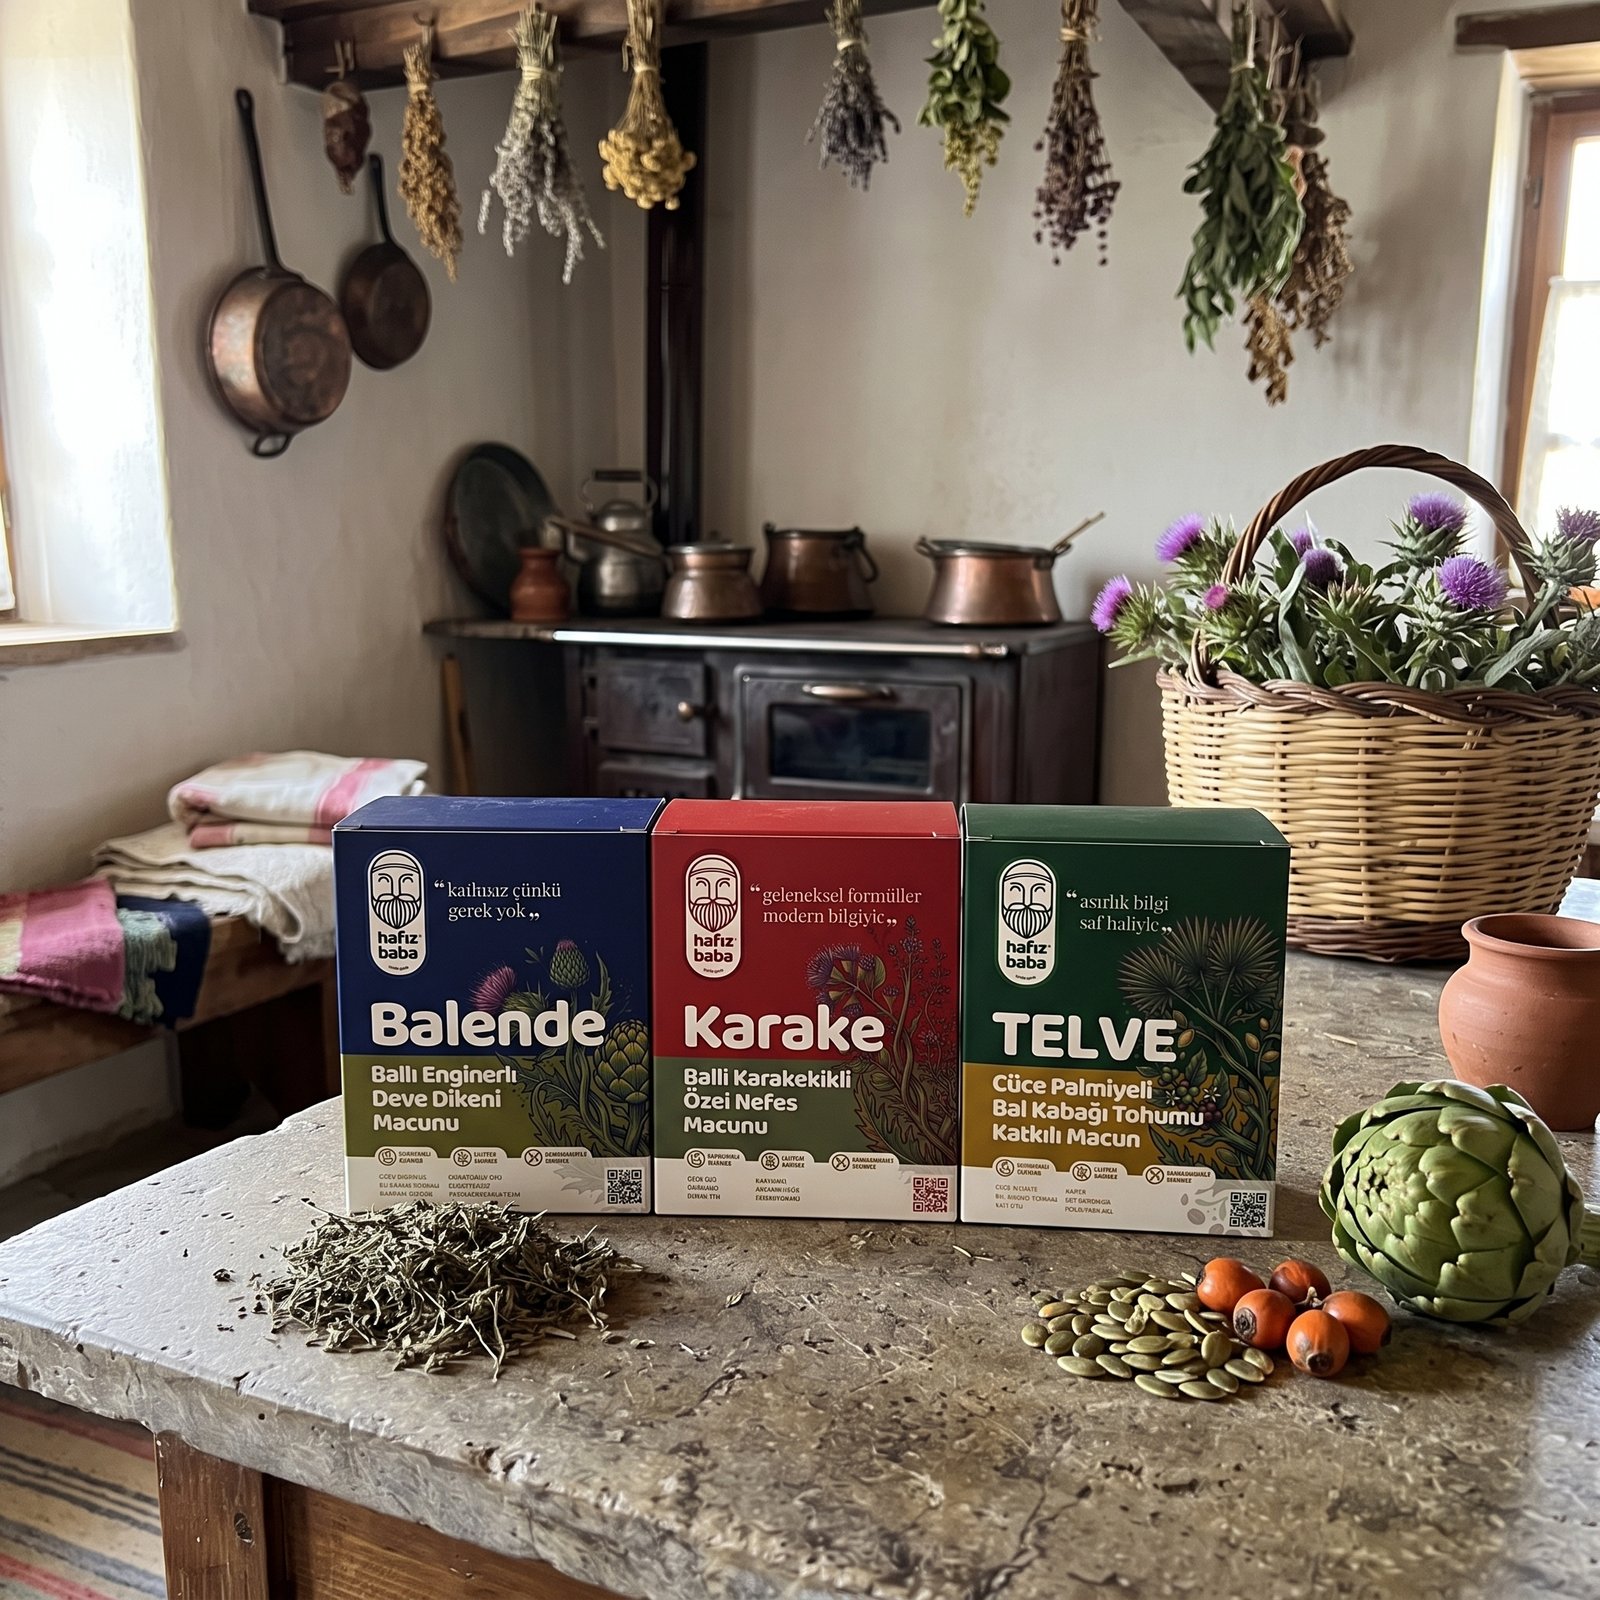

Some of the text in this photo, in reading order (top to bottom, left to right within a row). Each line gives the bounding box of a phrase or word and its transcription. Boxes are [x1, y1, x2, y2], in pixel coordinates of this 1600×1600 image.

[512, 882, 562, 901] çünkü
[847, 888, 922, 904] formüller
[448, 902, 493, 922] gerek
[1133, 894, 1169, 914] bilgi
[763, 908, 824, 924] modern
[1079, 915, 1104, 931] saf
[378, 945, 418, 960] baba
[694, 949, 733, 963] baba
[1006, 955, 1046, 970] baba
[370, 999, 606, 1047] Balende
[684, 1004, 885, 1052] Karake
[992, 1011, 1178, 1063] TELVE
[371, 1065, 418, 1084] Ballı
[684, 1068, 852, 1089] Balli Karakekikli
[992, 1073, 1153, 1102] Cüce Palmiyeli
[372, 1088, 502, 1108] Deve Dikeni
[683, 1087, 799, 1112] Özei Nefes
[992, 1098, 1204, 1127] Bal Kabağı Tohumu
[373, 1114, 460, 1132] Macunu
[683, 1116, 769, 1135] Macunu
[992, 1123, 1141, 1149] Katkılı Macun
